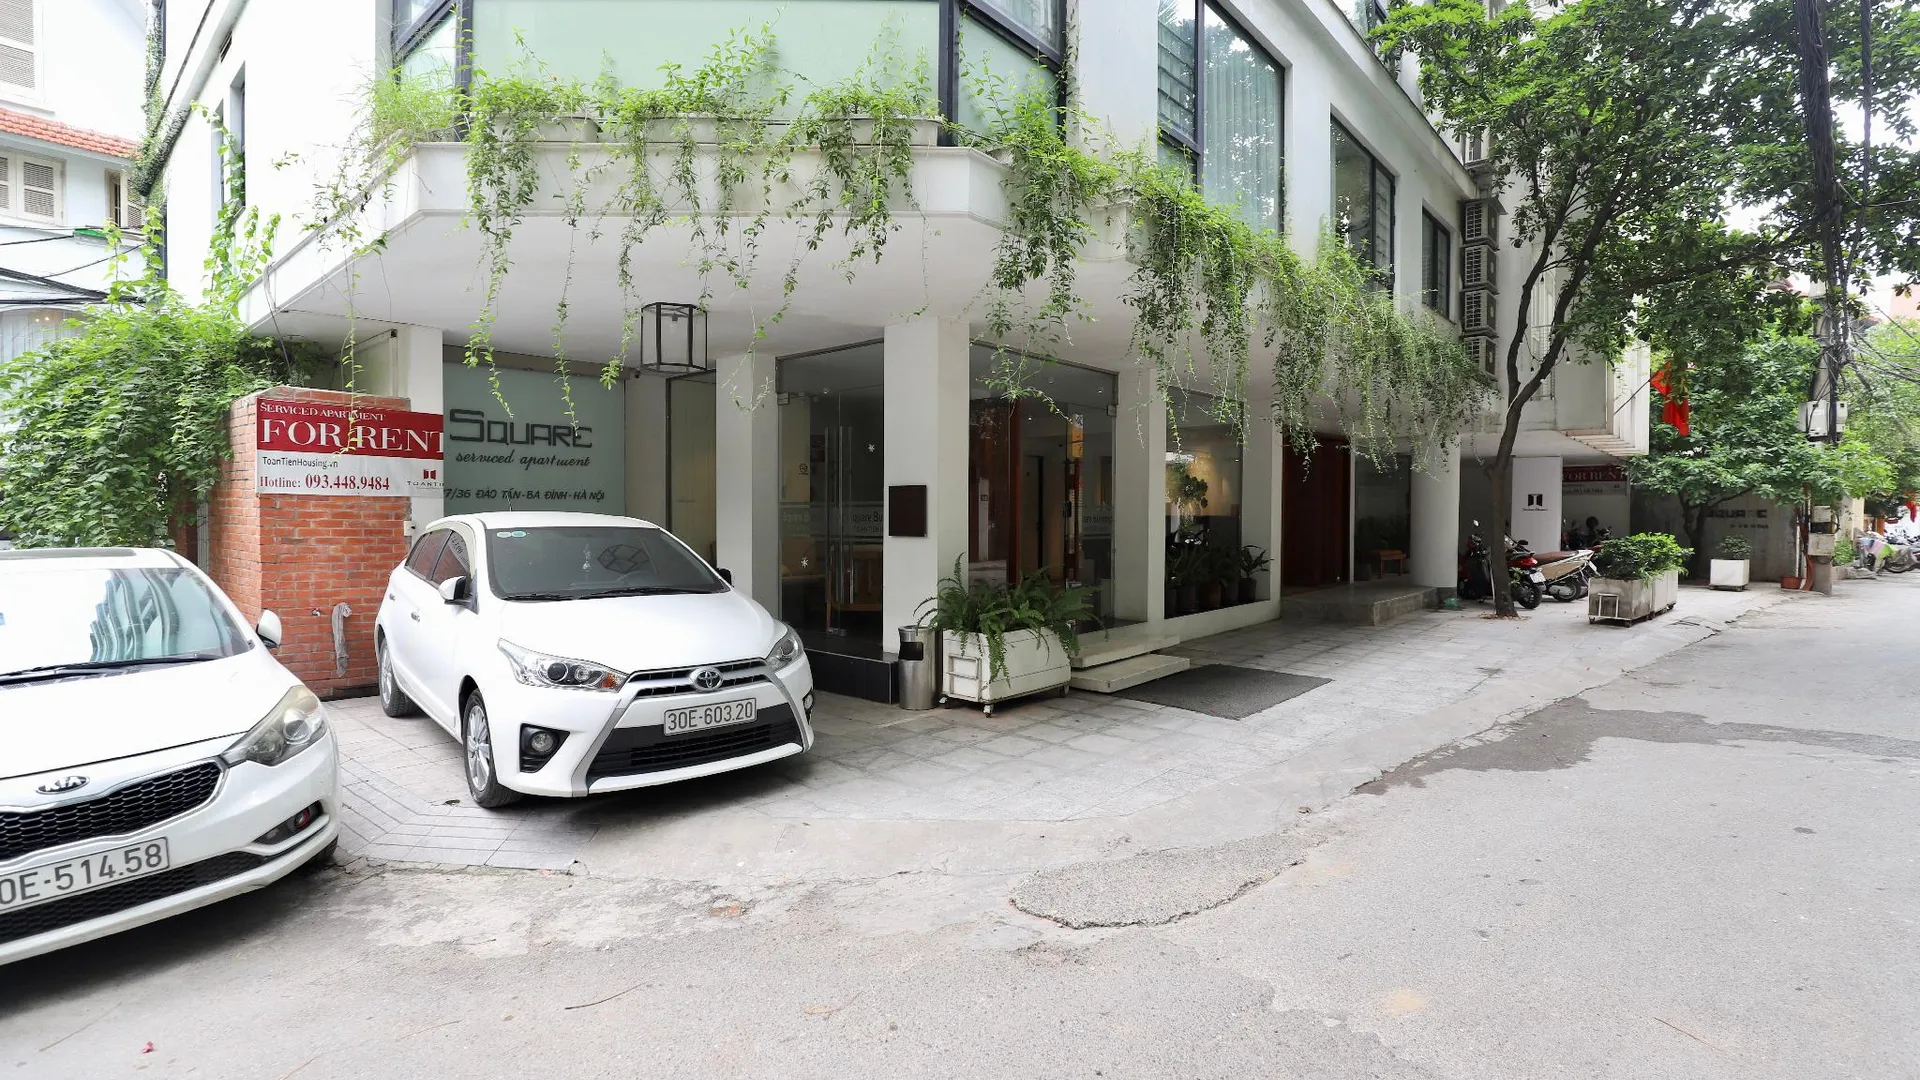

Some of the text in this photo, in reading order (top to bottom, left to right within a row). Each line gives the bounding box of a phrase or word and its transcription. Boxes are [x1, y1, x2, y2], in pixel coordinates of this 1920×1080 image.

[260, 418, 344, 448] FOR
[455, 448, 591, 471] serviced apartment
[260, 473, 390, 490] Hotline: 093.448.9484
[668, 701, 753, 731] 30E-603.20
[39, 776, 88, 793] KIA
